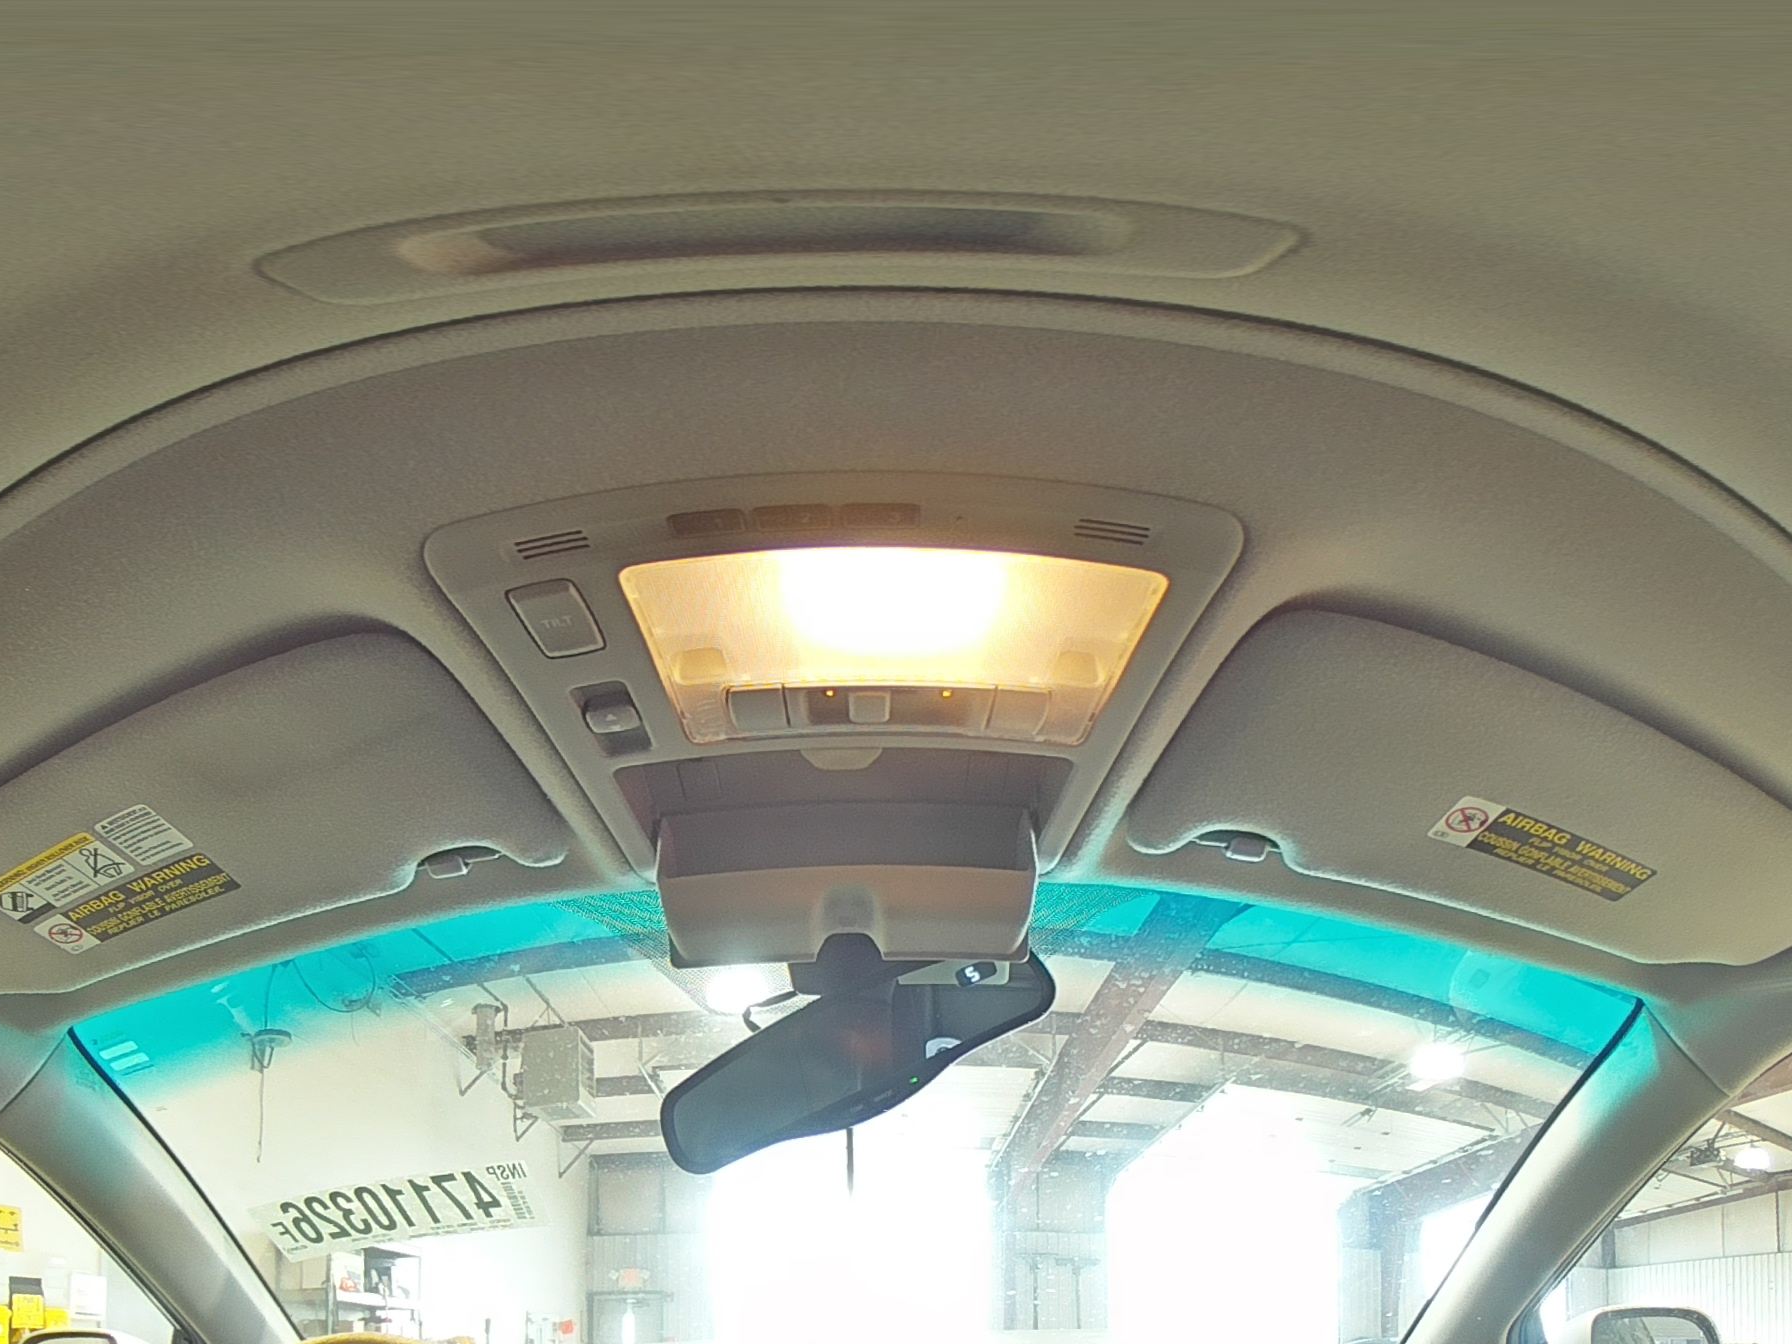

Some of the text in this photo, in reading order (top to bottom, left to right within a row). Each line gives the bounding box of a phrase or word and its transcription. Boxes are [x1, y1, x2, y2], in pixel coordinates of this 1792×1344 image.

[540, 614, 572, 629] TILT
[1499, 813, 1652, 880] AIRBAG WARNING
[68, 891, 126, 921] AIRBAG
[127, 855, 211, 892] WARNING
[108, 879, 183, 913] FLIP VISOR OVER
[164, 873, 231, 901] AVERTISSEMENT
